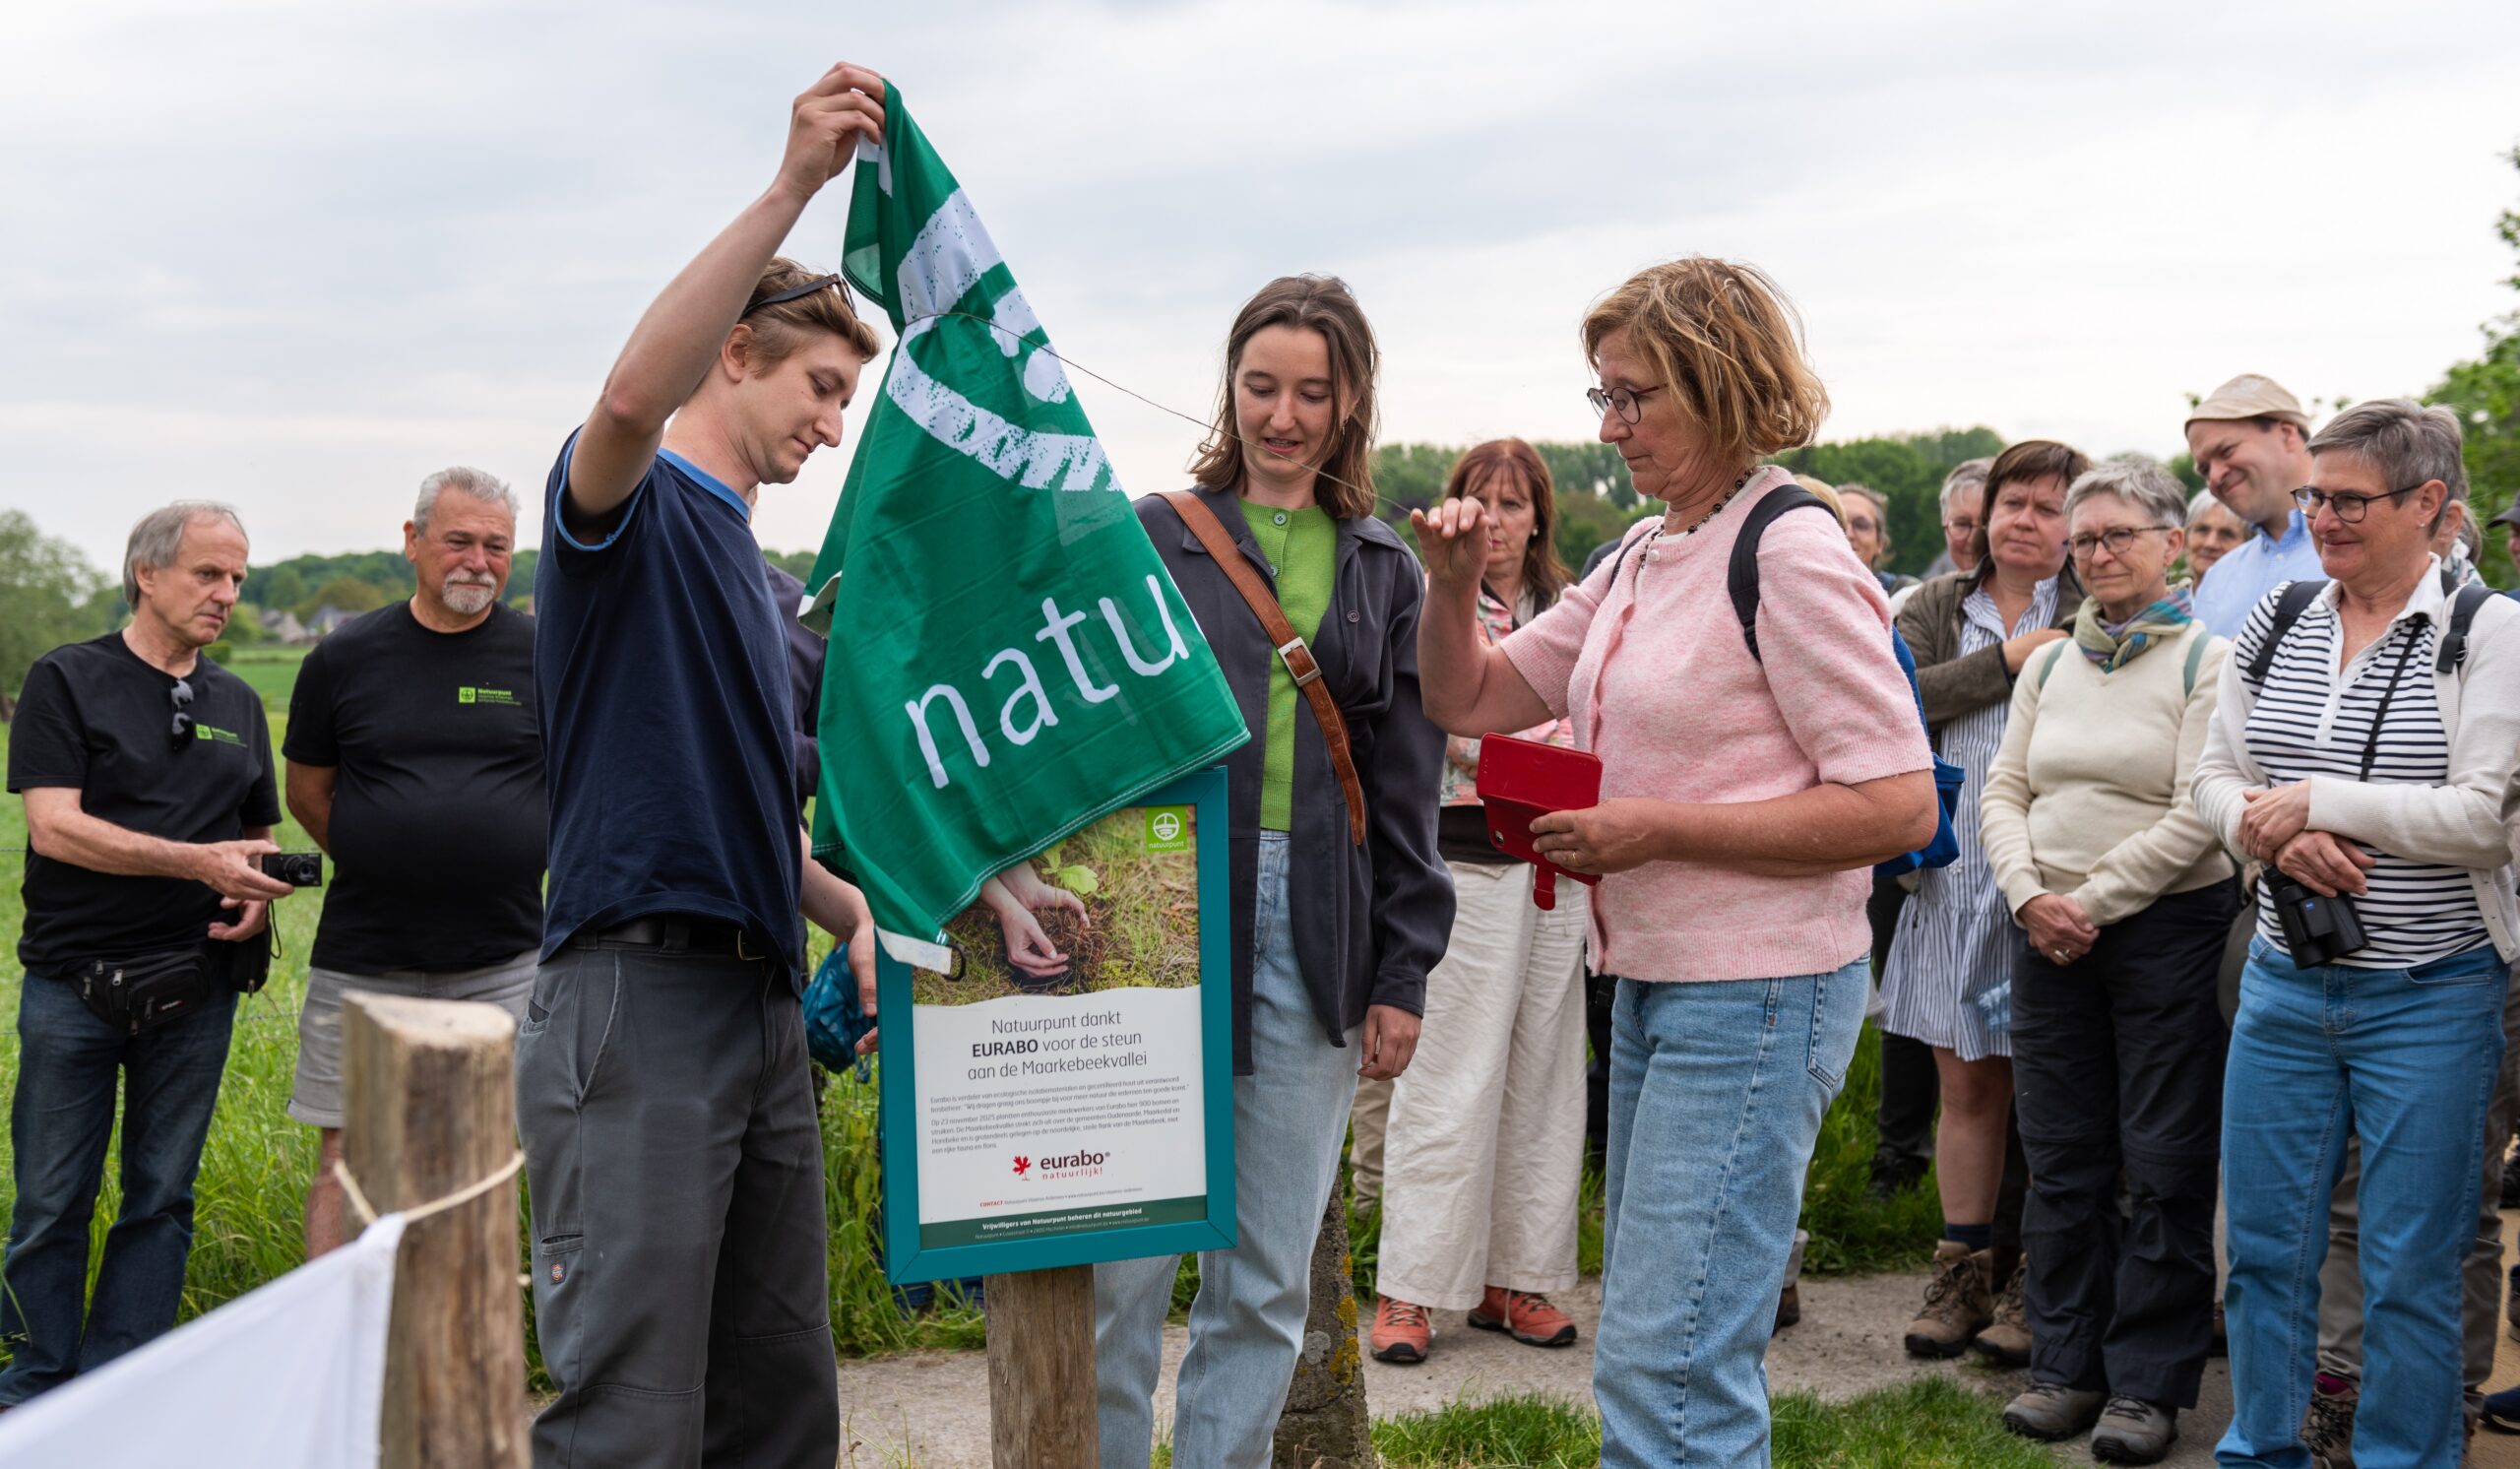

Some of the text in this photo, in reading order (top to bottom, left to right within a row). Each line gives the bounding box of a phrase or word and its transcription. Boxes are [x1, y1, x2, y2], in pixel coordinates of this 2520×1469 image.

[992, 1010, 1121, 1034] Natuurpunt dankt
[973, 1032, 1142, 1057] EURABO voor de steun
[968, 1051, 1147, 1080] aan de Maarkebeekvallei
[1042, 1167, 1102, 1181] natuurlijk!
[982, 1221, 1018, 1231] Vrijwilligers
[1032, 1215, 1066, 1225] Natuurpunt
[1102, 1207, 1142, 1218] natuurgebied
